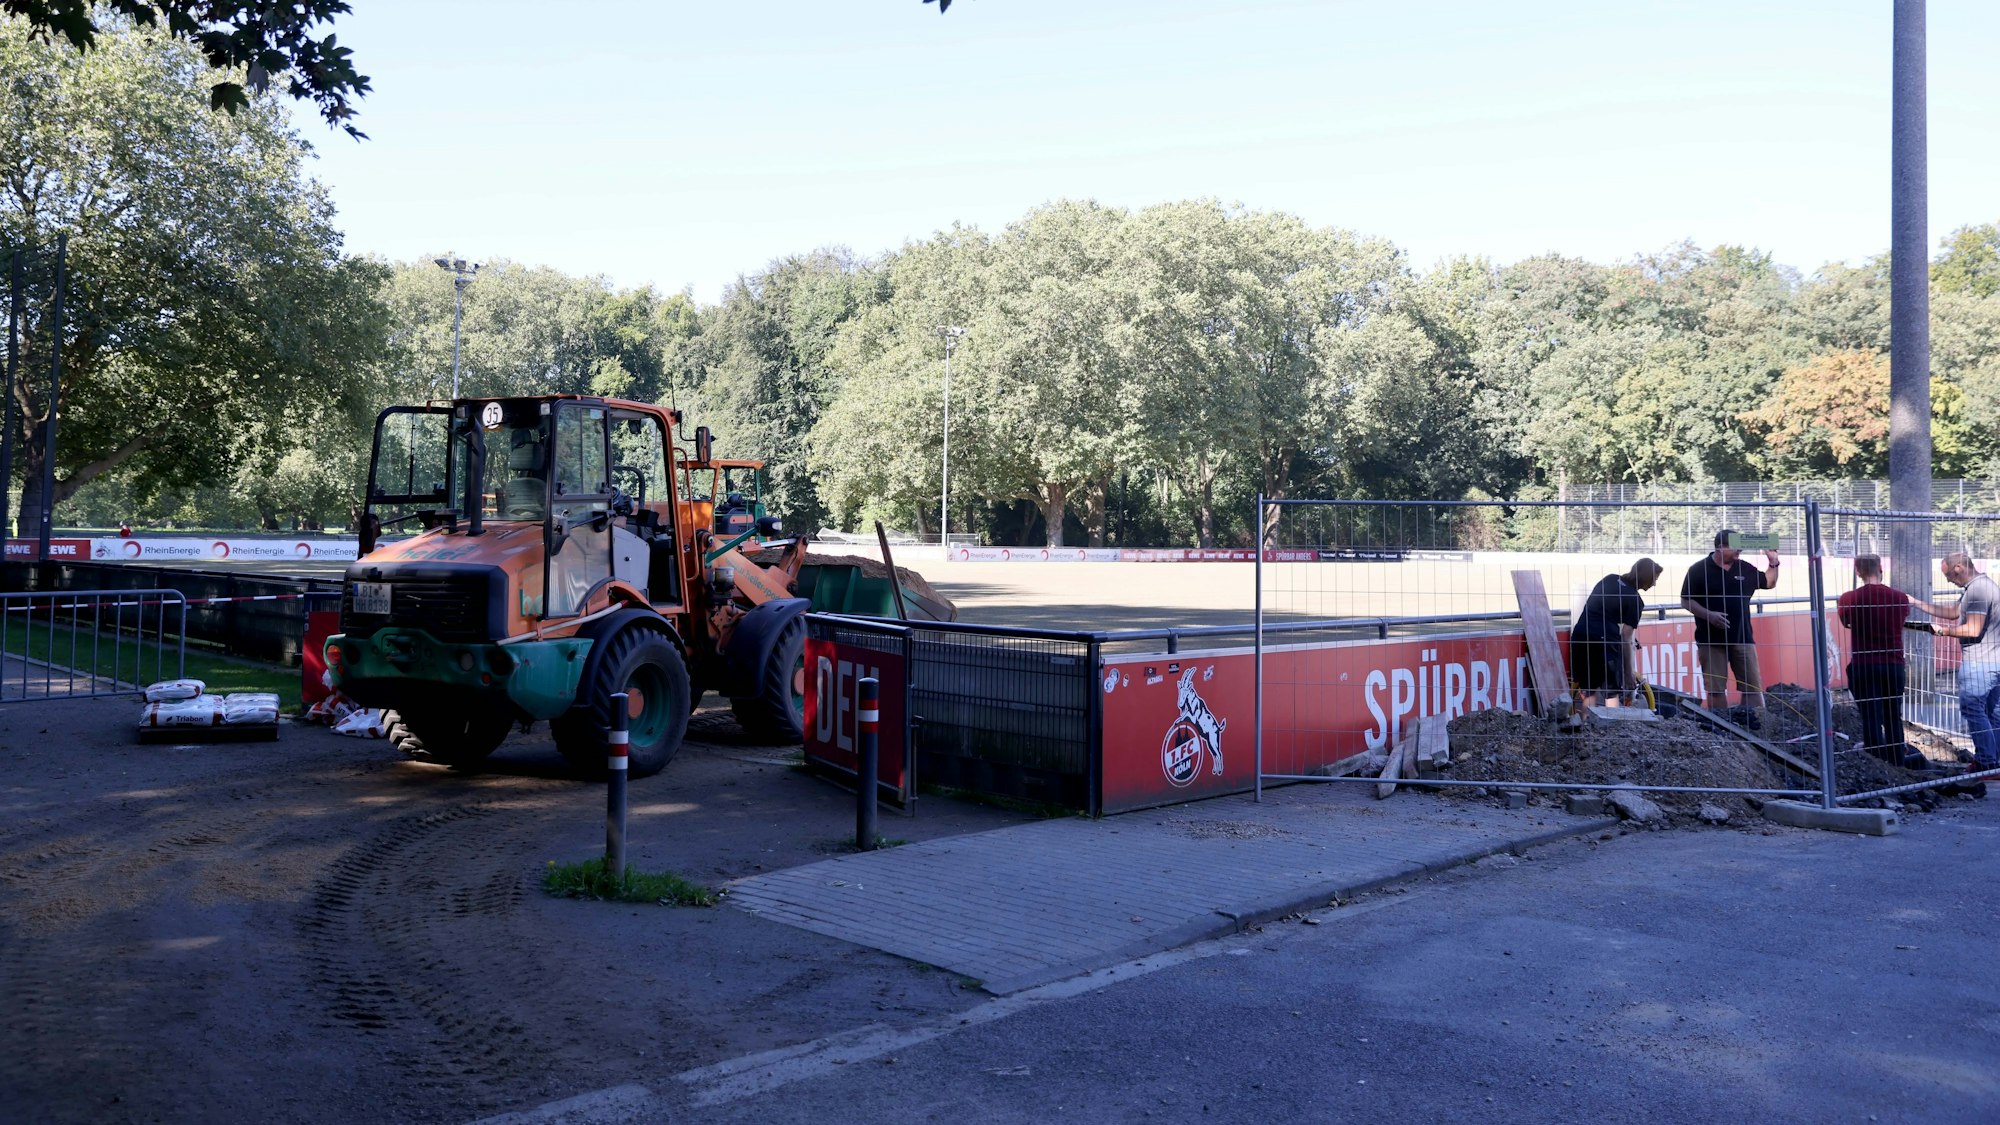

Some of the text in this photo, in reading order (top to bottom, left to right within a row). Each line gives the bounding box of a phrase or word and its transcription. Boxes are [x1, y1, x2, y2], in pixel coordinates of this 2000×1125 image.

[487, 406, 498, 424] 35
[49, 545, 76, 555] EWE
[144, 546, 200, 555] RheinEnergie
[232, 547, 285, 555] RheinEnergie
[1635, 641, 1728, 700] NDER
